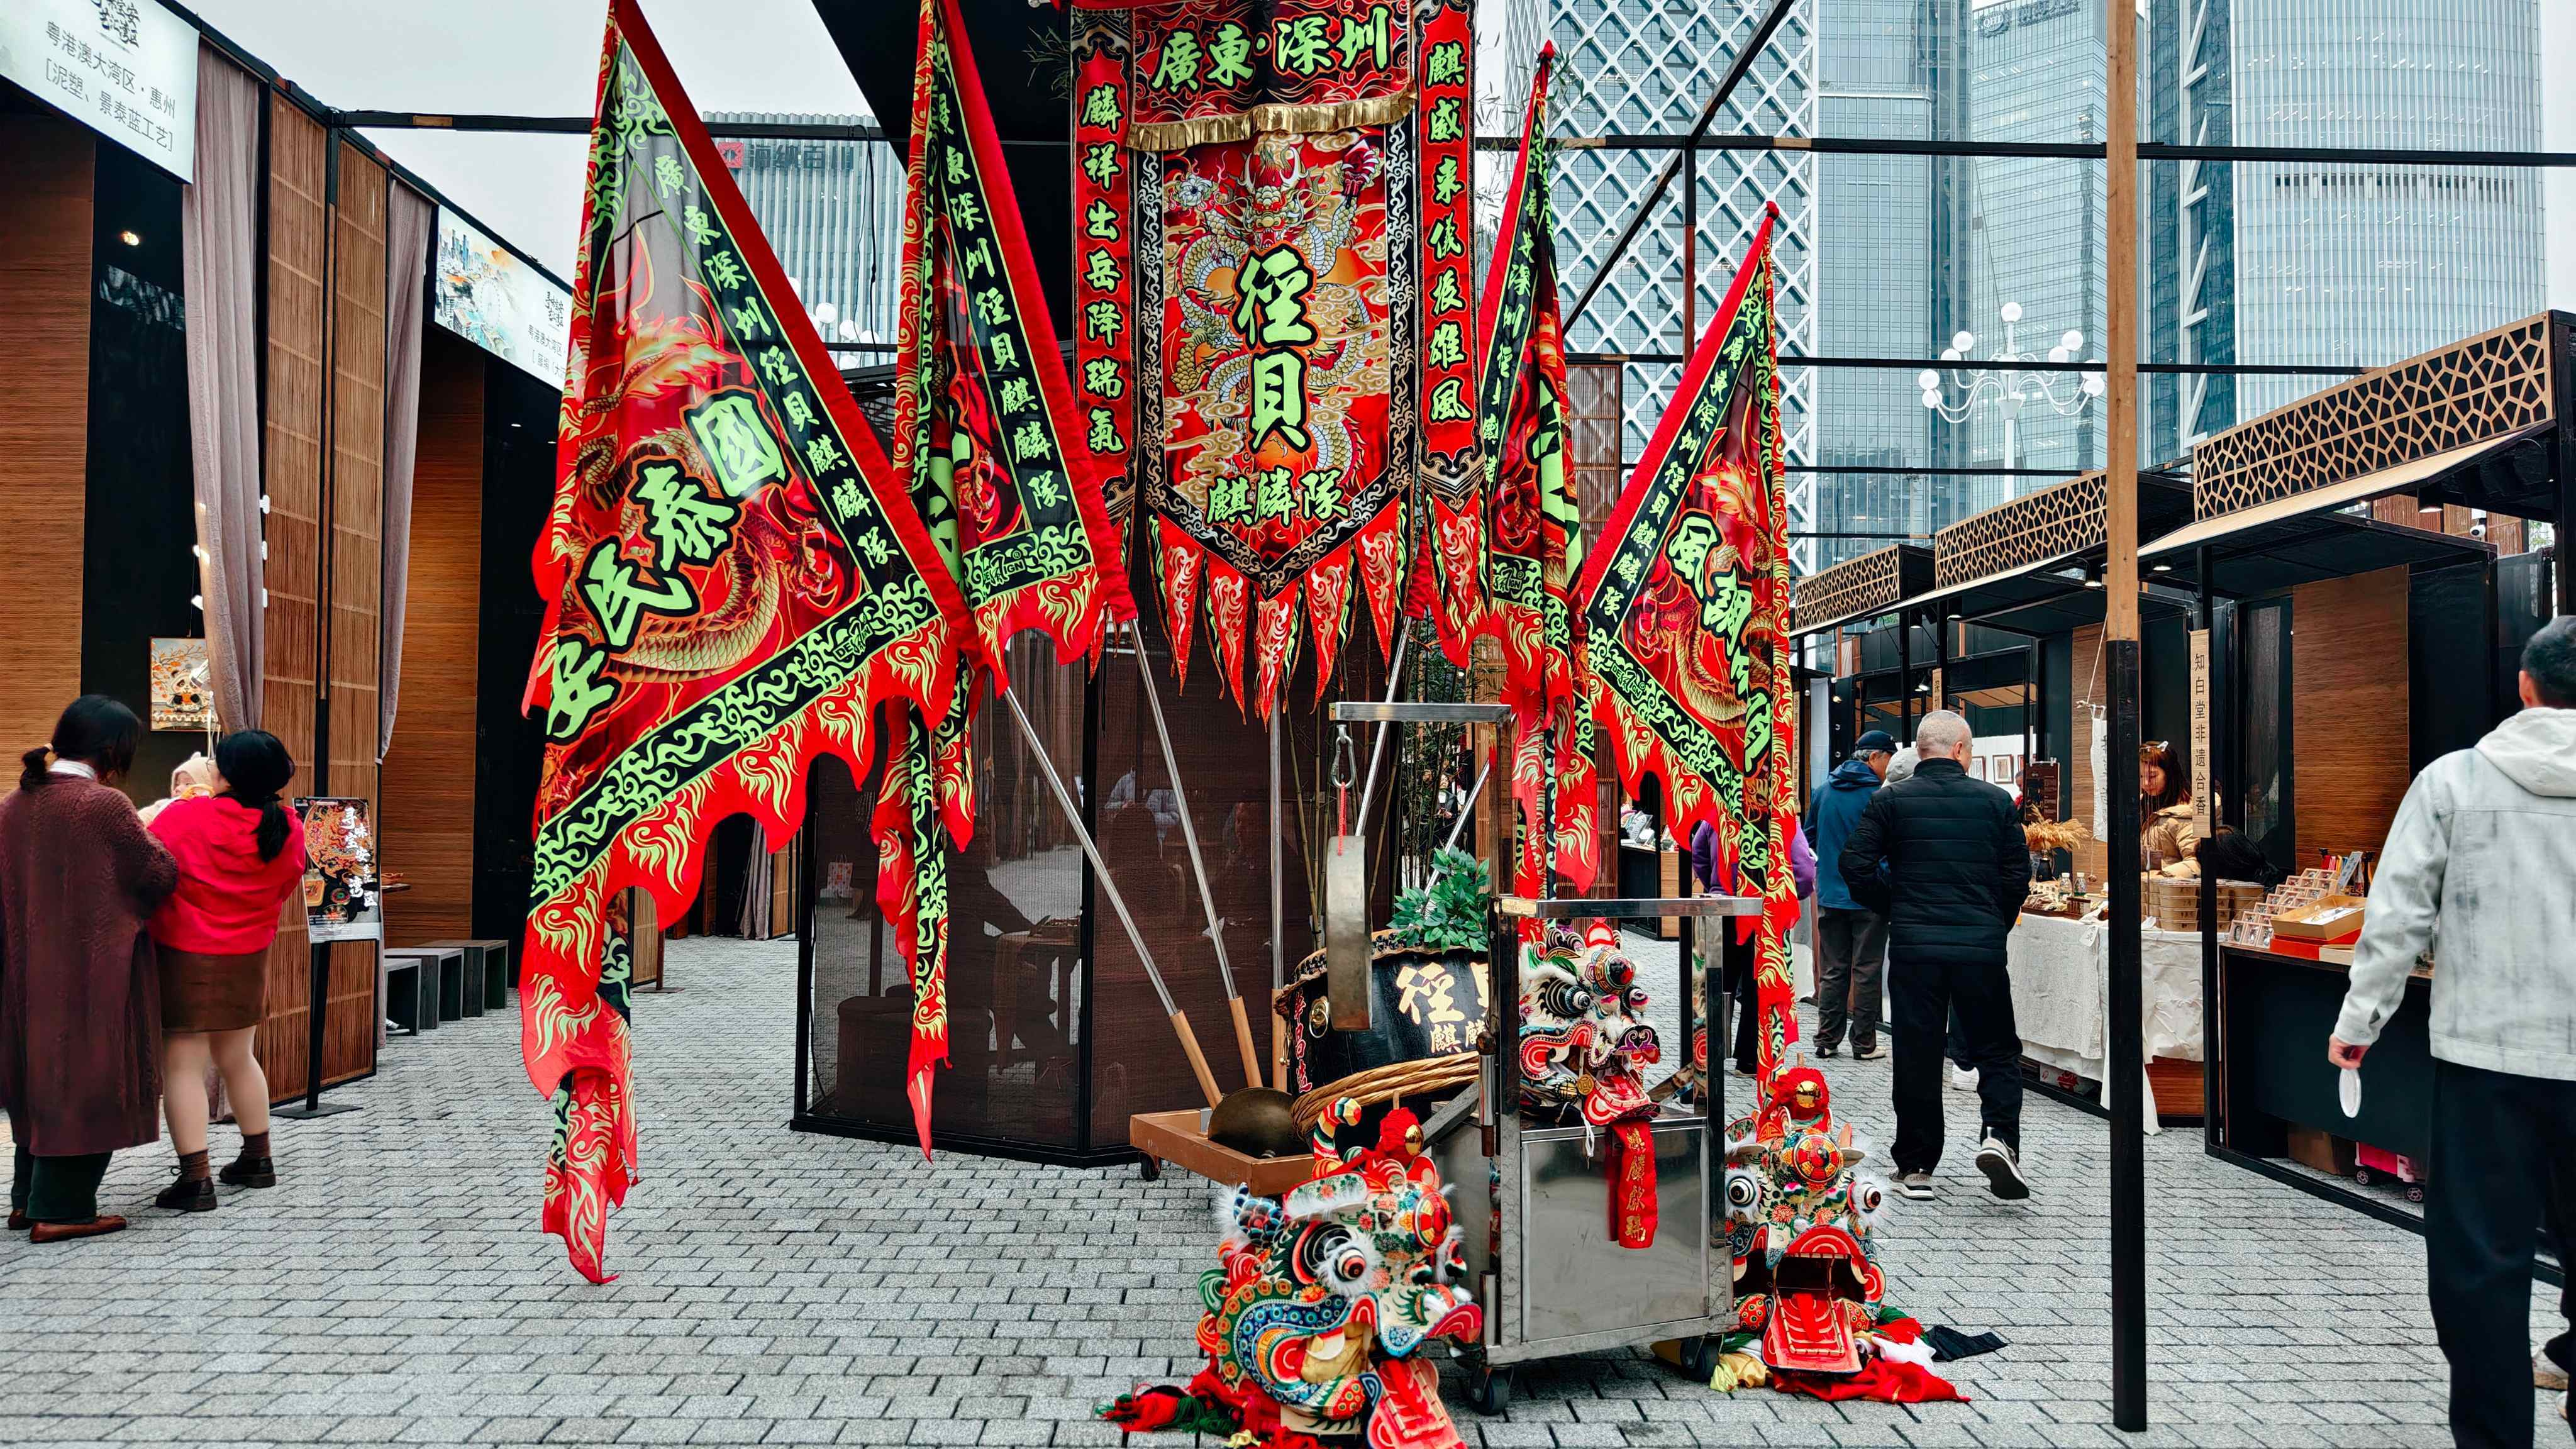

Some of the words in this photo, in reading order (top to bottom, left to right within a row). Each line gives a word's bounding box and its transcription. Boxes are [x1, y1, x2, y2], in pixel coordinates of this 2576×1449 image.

[45, 21, 175, 118] 粤港澳大湾区·惠州
[2194, 653, 2206, 816] 知白堂非遗合香
